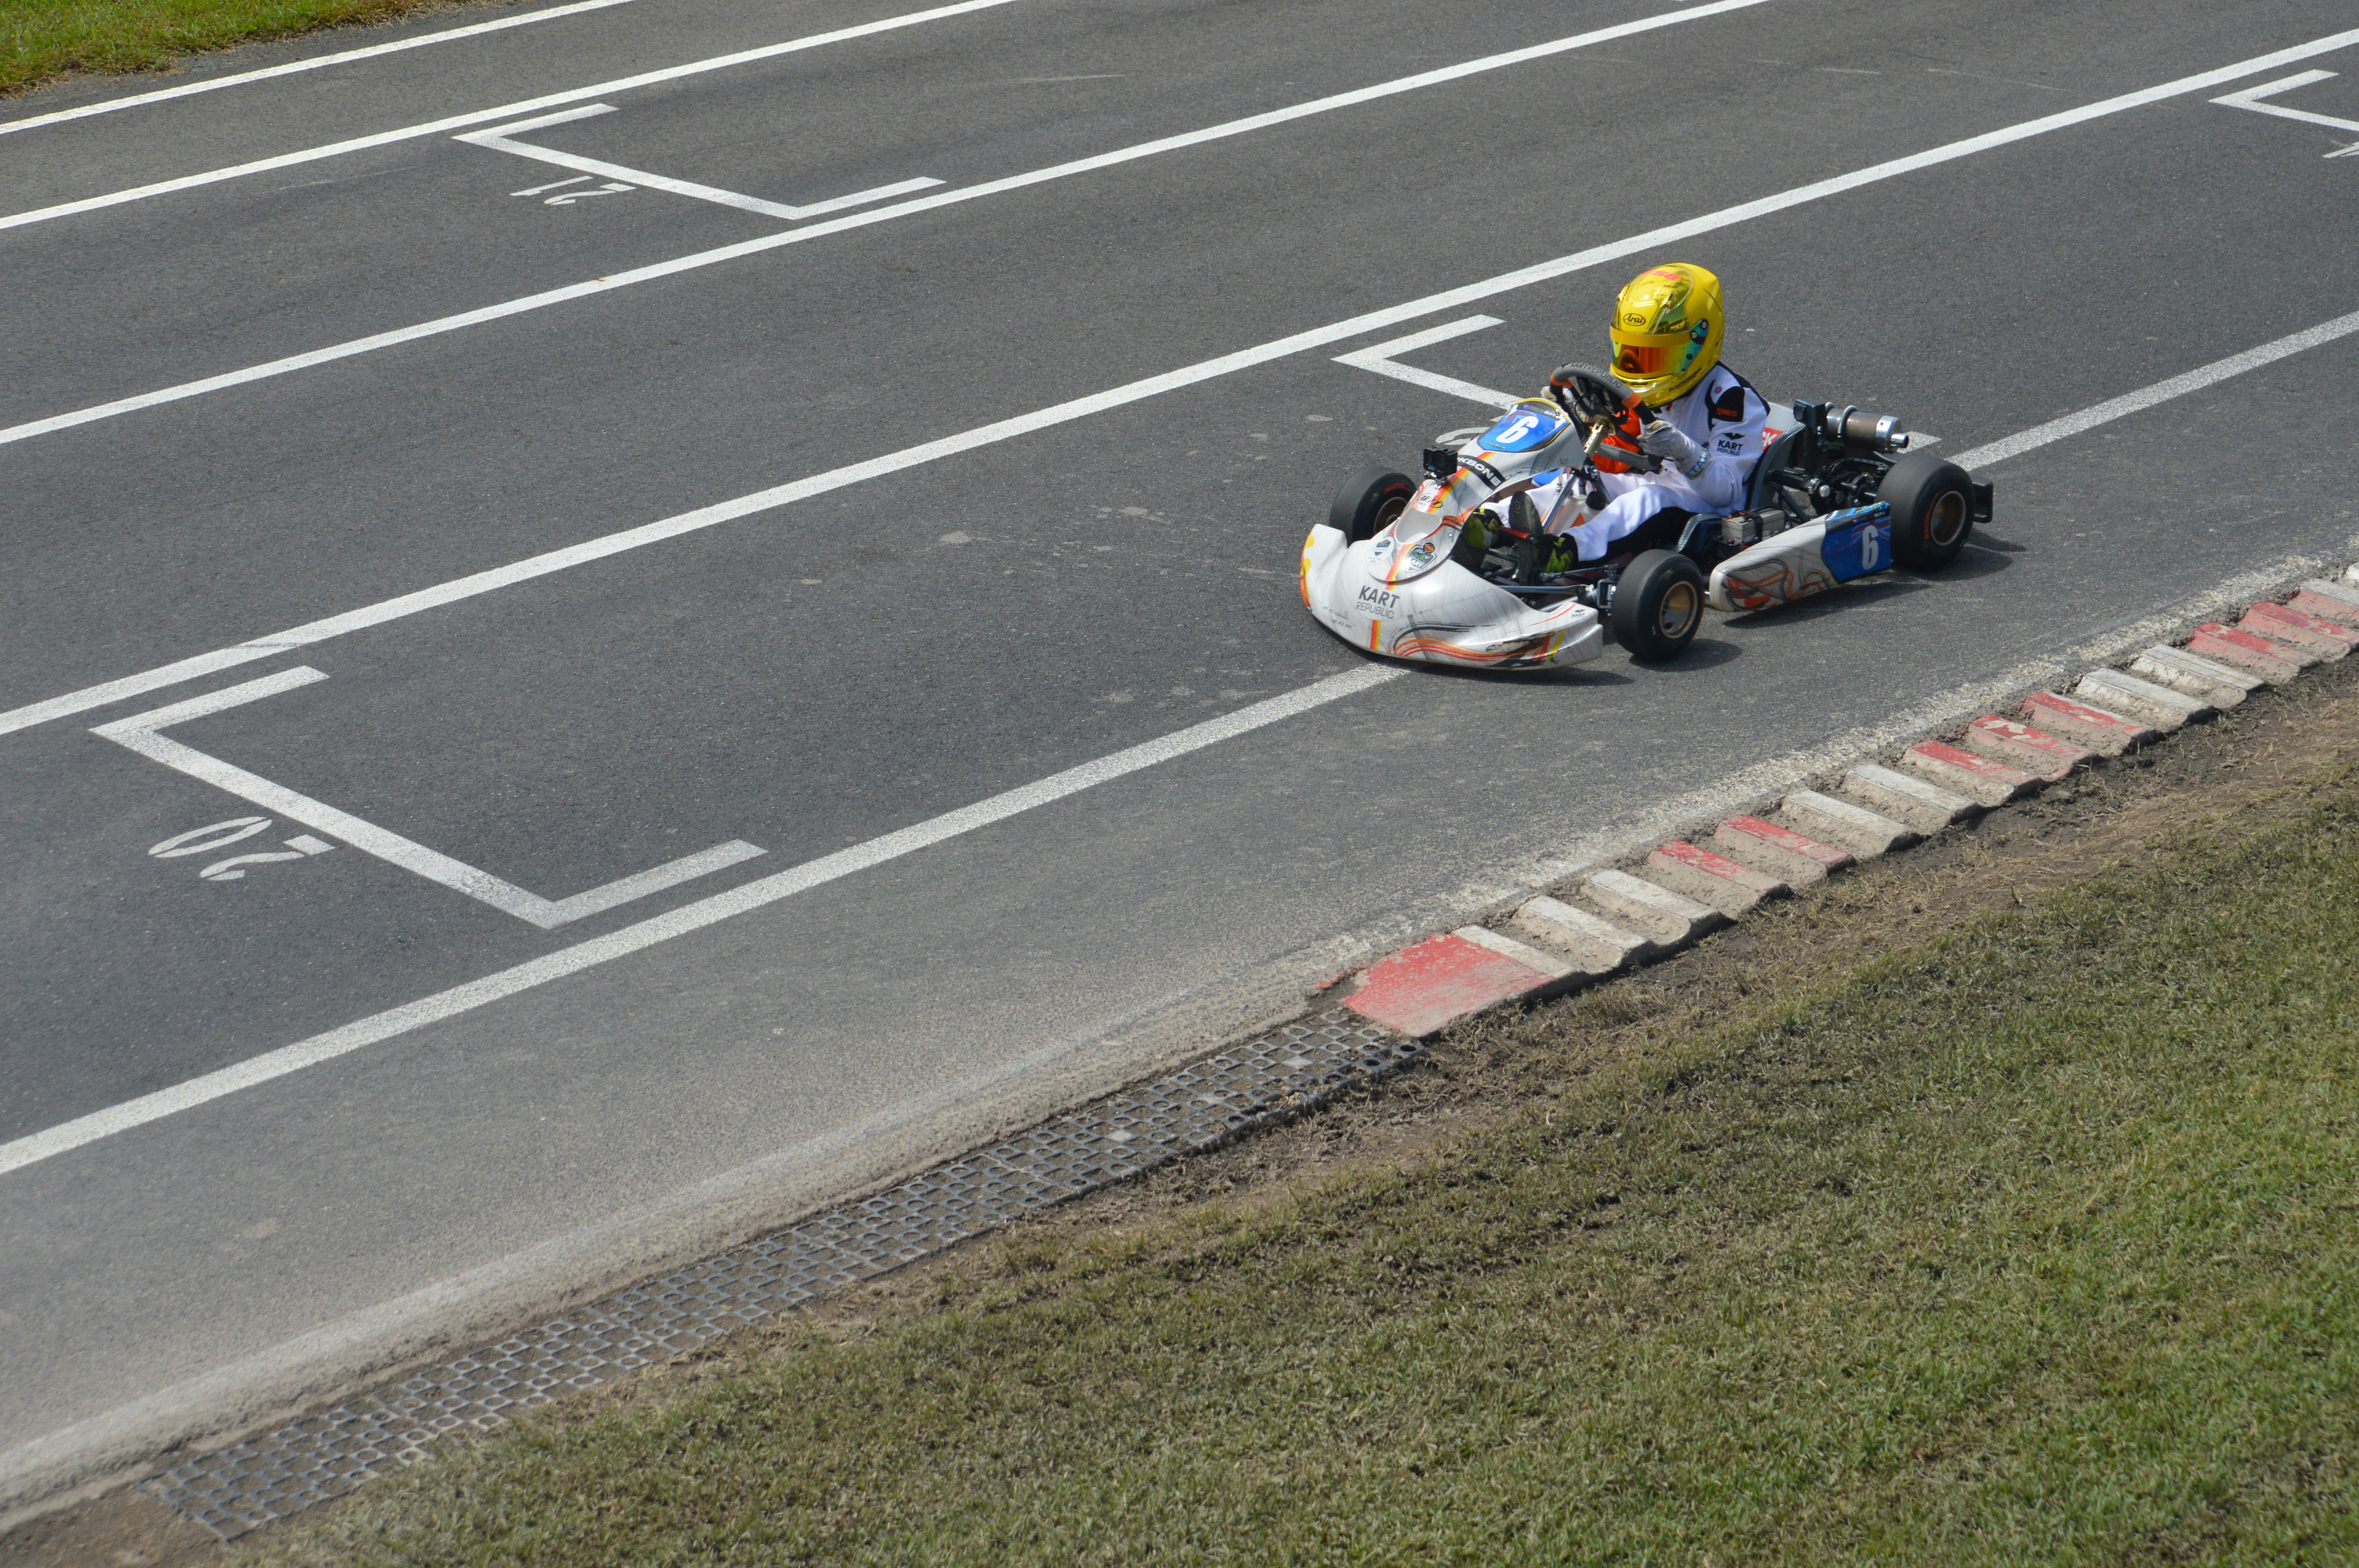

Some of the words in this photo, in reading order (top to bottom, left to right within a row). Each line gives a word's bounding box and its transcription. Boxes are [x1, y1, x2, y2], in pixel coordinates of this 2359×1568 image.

[1624, 314, 1644, 323] Arai
[1496, 416, 1539, 443] 6
[1717, 447, 1741, 456] REPUBLIC
[1718, 439, 1743, 451] KART
[1862, 525, 1879, 570] 6
[1359, 586, 1400, 608] KART
[1355, 601, 1395, 619] REPUBLIC
